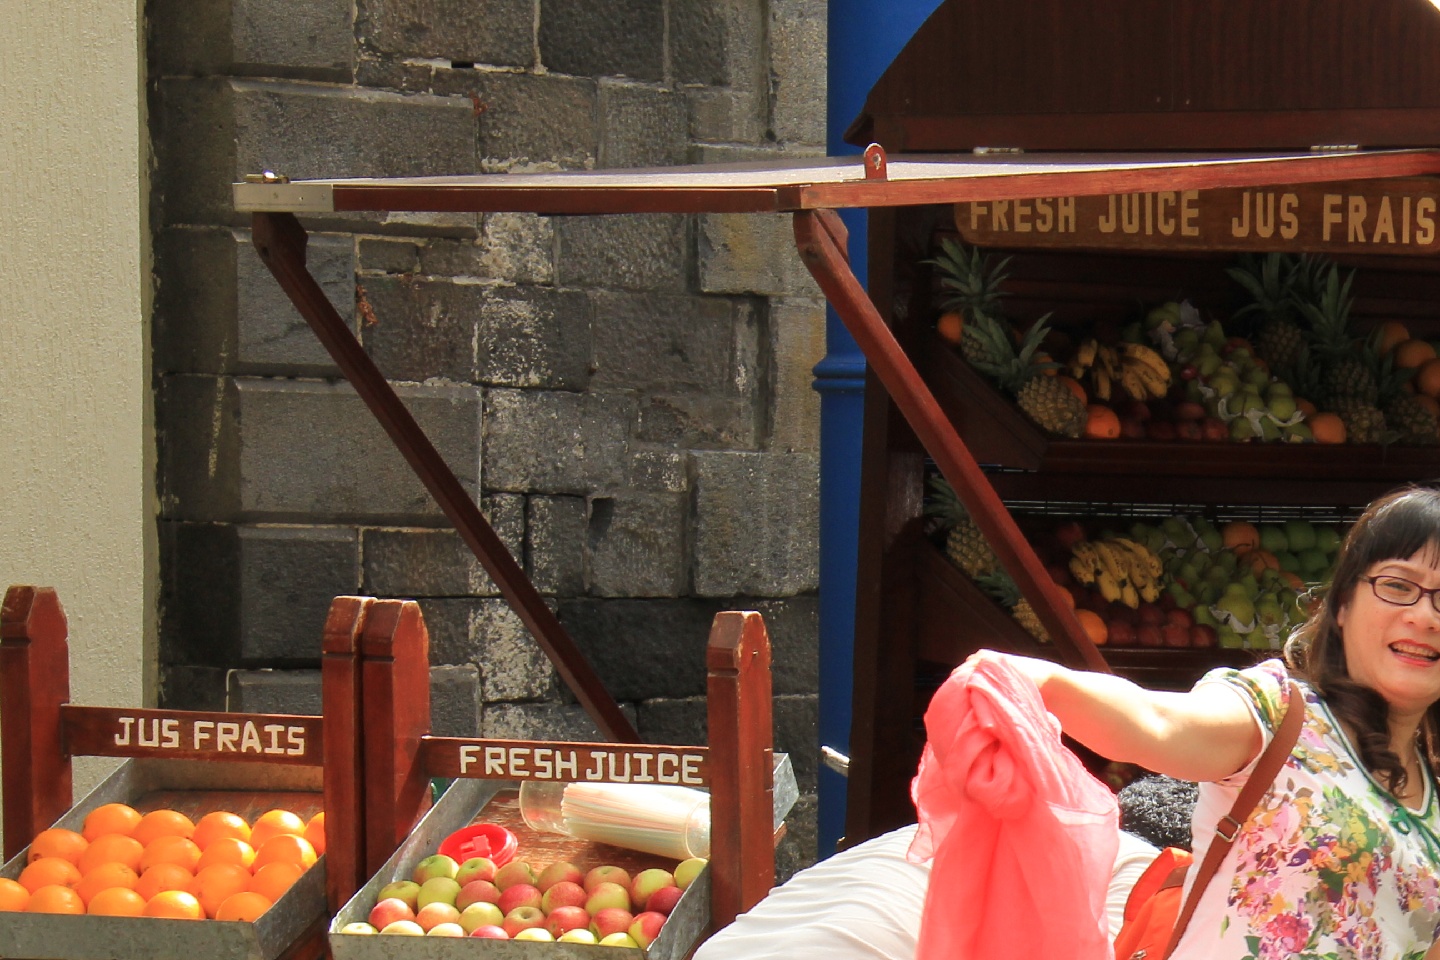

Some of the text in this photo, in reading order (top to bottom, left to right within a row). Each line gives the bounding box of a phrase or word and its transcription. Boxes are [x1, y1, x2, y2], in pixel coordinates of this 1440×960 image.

[970, 190, 1436, 245] FRESH JUICE JUS FRAIS
[114, 717, 306, 755] JUS FRAIS
[459, 745, 704, 785] FRESH JUICE
